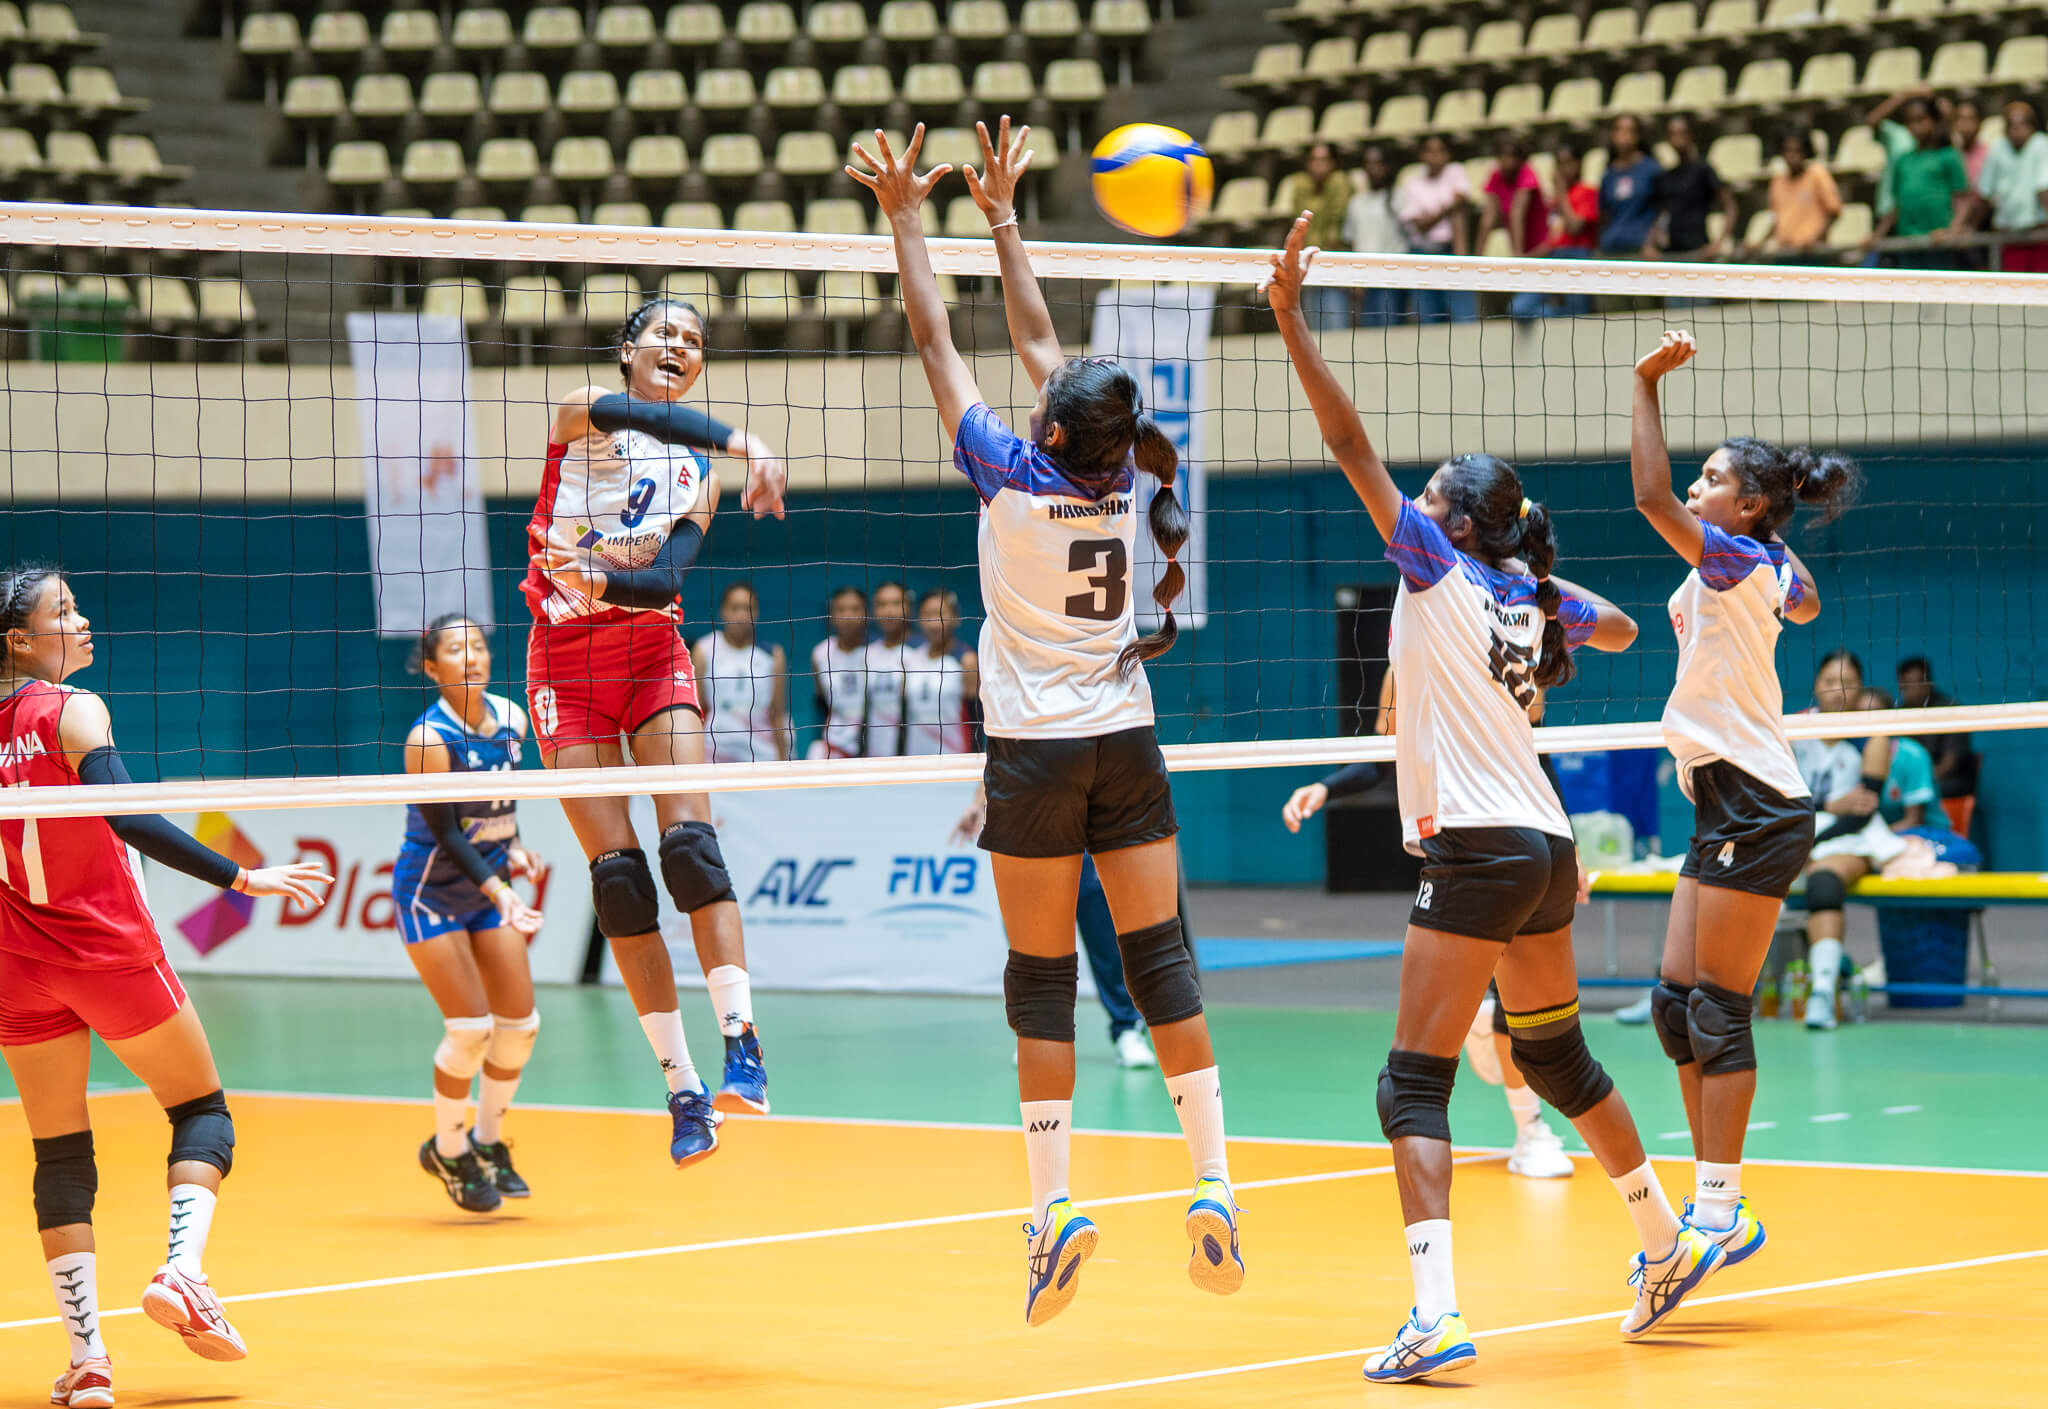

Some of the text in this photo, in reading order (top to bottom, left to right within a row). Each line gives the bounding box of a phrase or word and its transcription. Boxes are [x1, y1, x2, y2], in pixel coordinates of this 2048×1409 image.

[620, 478, 657, 528] 9
[1049, 498, 1131, 519] HARSHIN
[1065, 538, 1127, 620] 3
[534, 687, 558, 736] 9
[888, 856, 978, 895] FIVB
[1717, 841, 1735, 867] 4
[277, 836, 552, 947] Diag
[747, 857, 855, 907] AVC
[1416, 880, 1434, 910] 12
